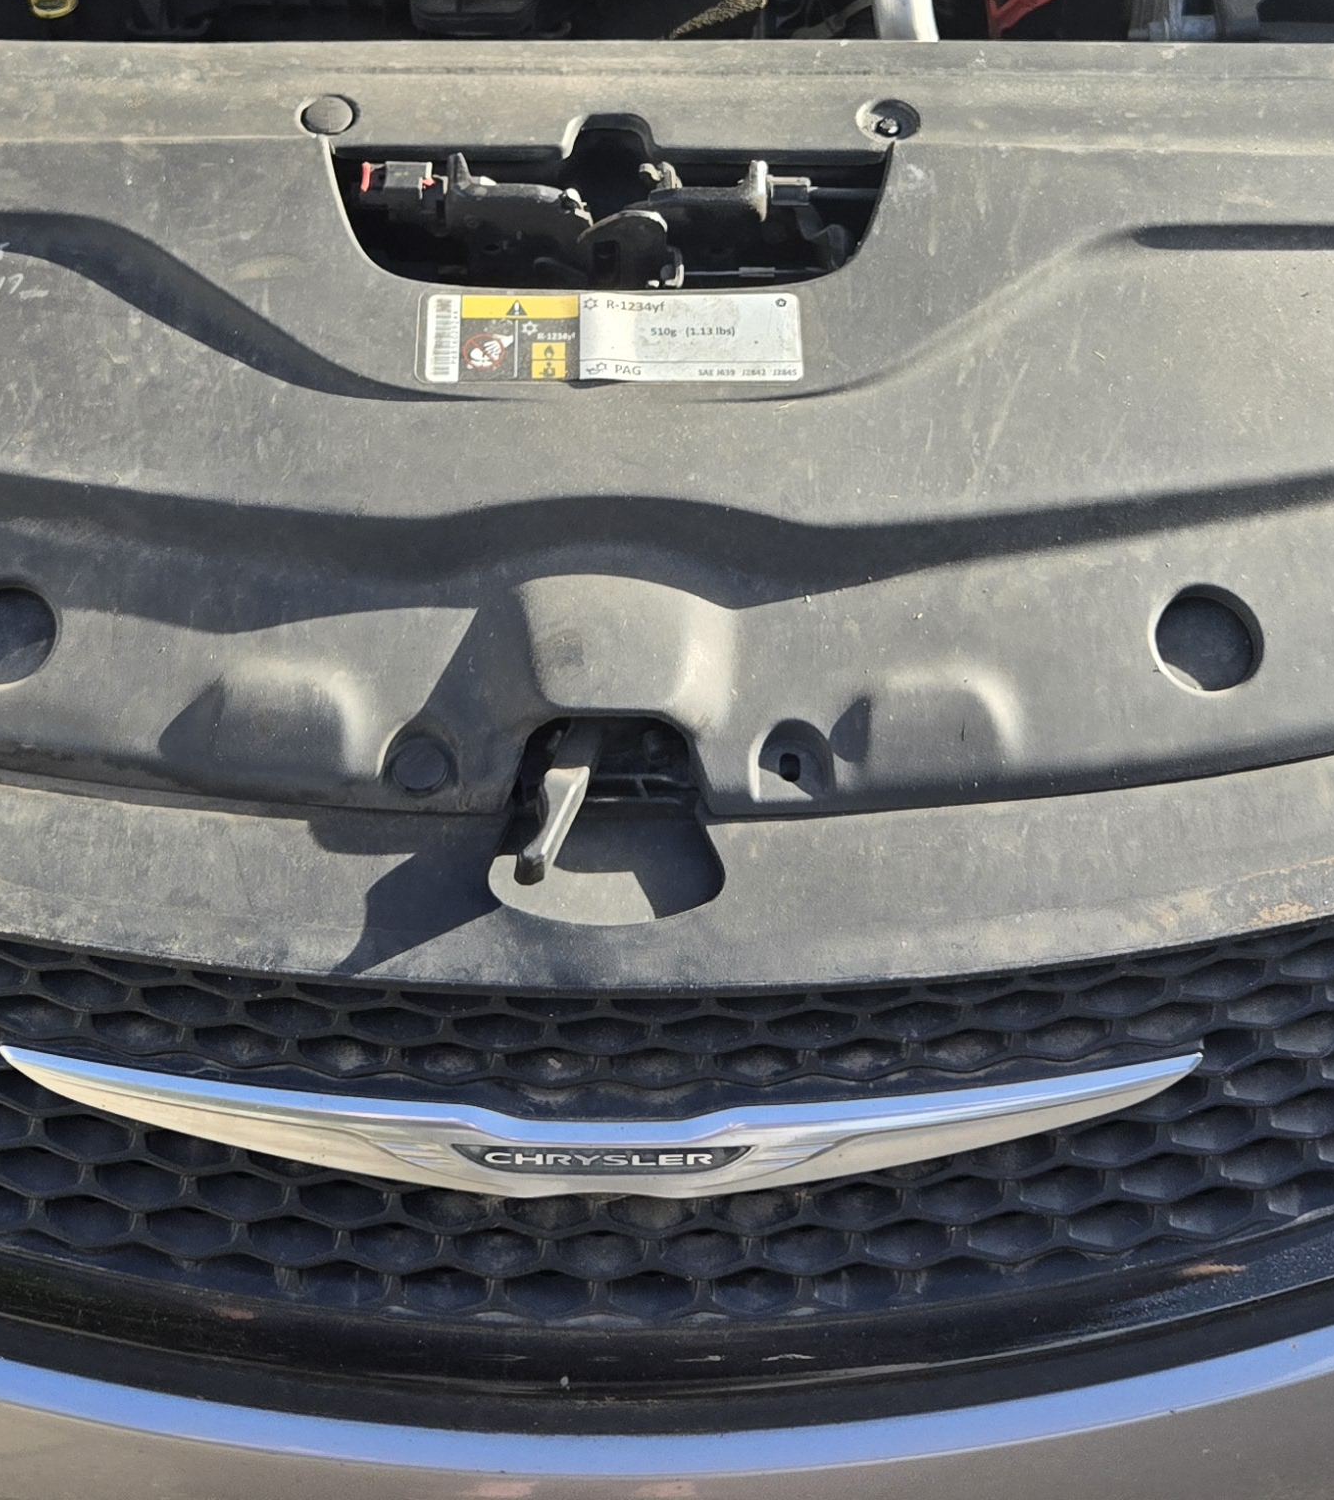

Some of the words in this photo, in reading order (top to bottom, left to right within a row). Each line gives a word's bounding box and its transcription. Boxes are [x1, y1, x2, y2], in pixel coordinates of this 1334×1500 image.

[606, 300, 666, 313] R-1234yf
[650, 327, 677, 338] 510g
[685, 326, 713, 338] (1.13
[716, 326, 736, 337] lbs)
[615, 364, 641, 376] PAG
[484, 1151, 713, 1167] CHRYSLER
